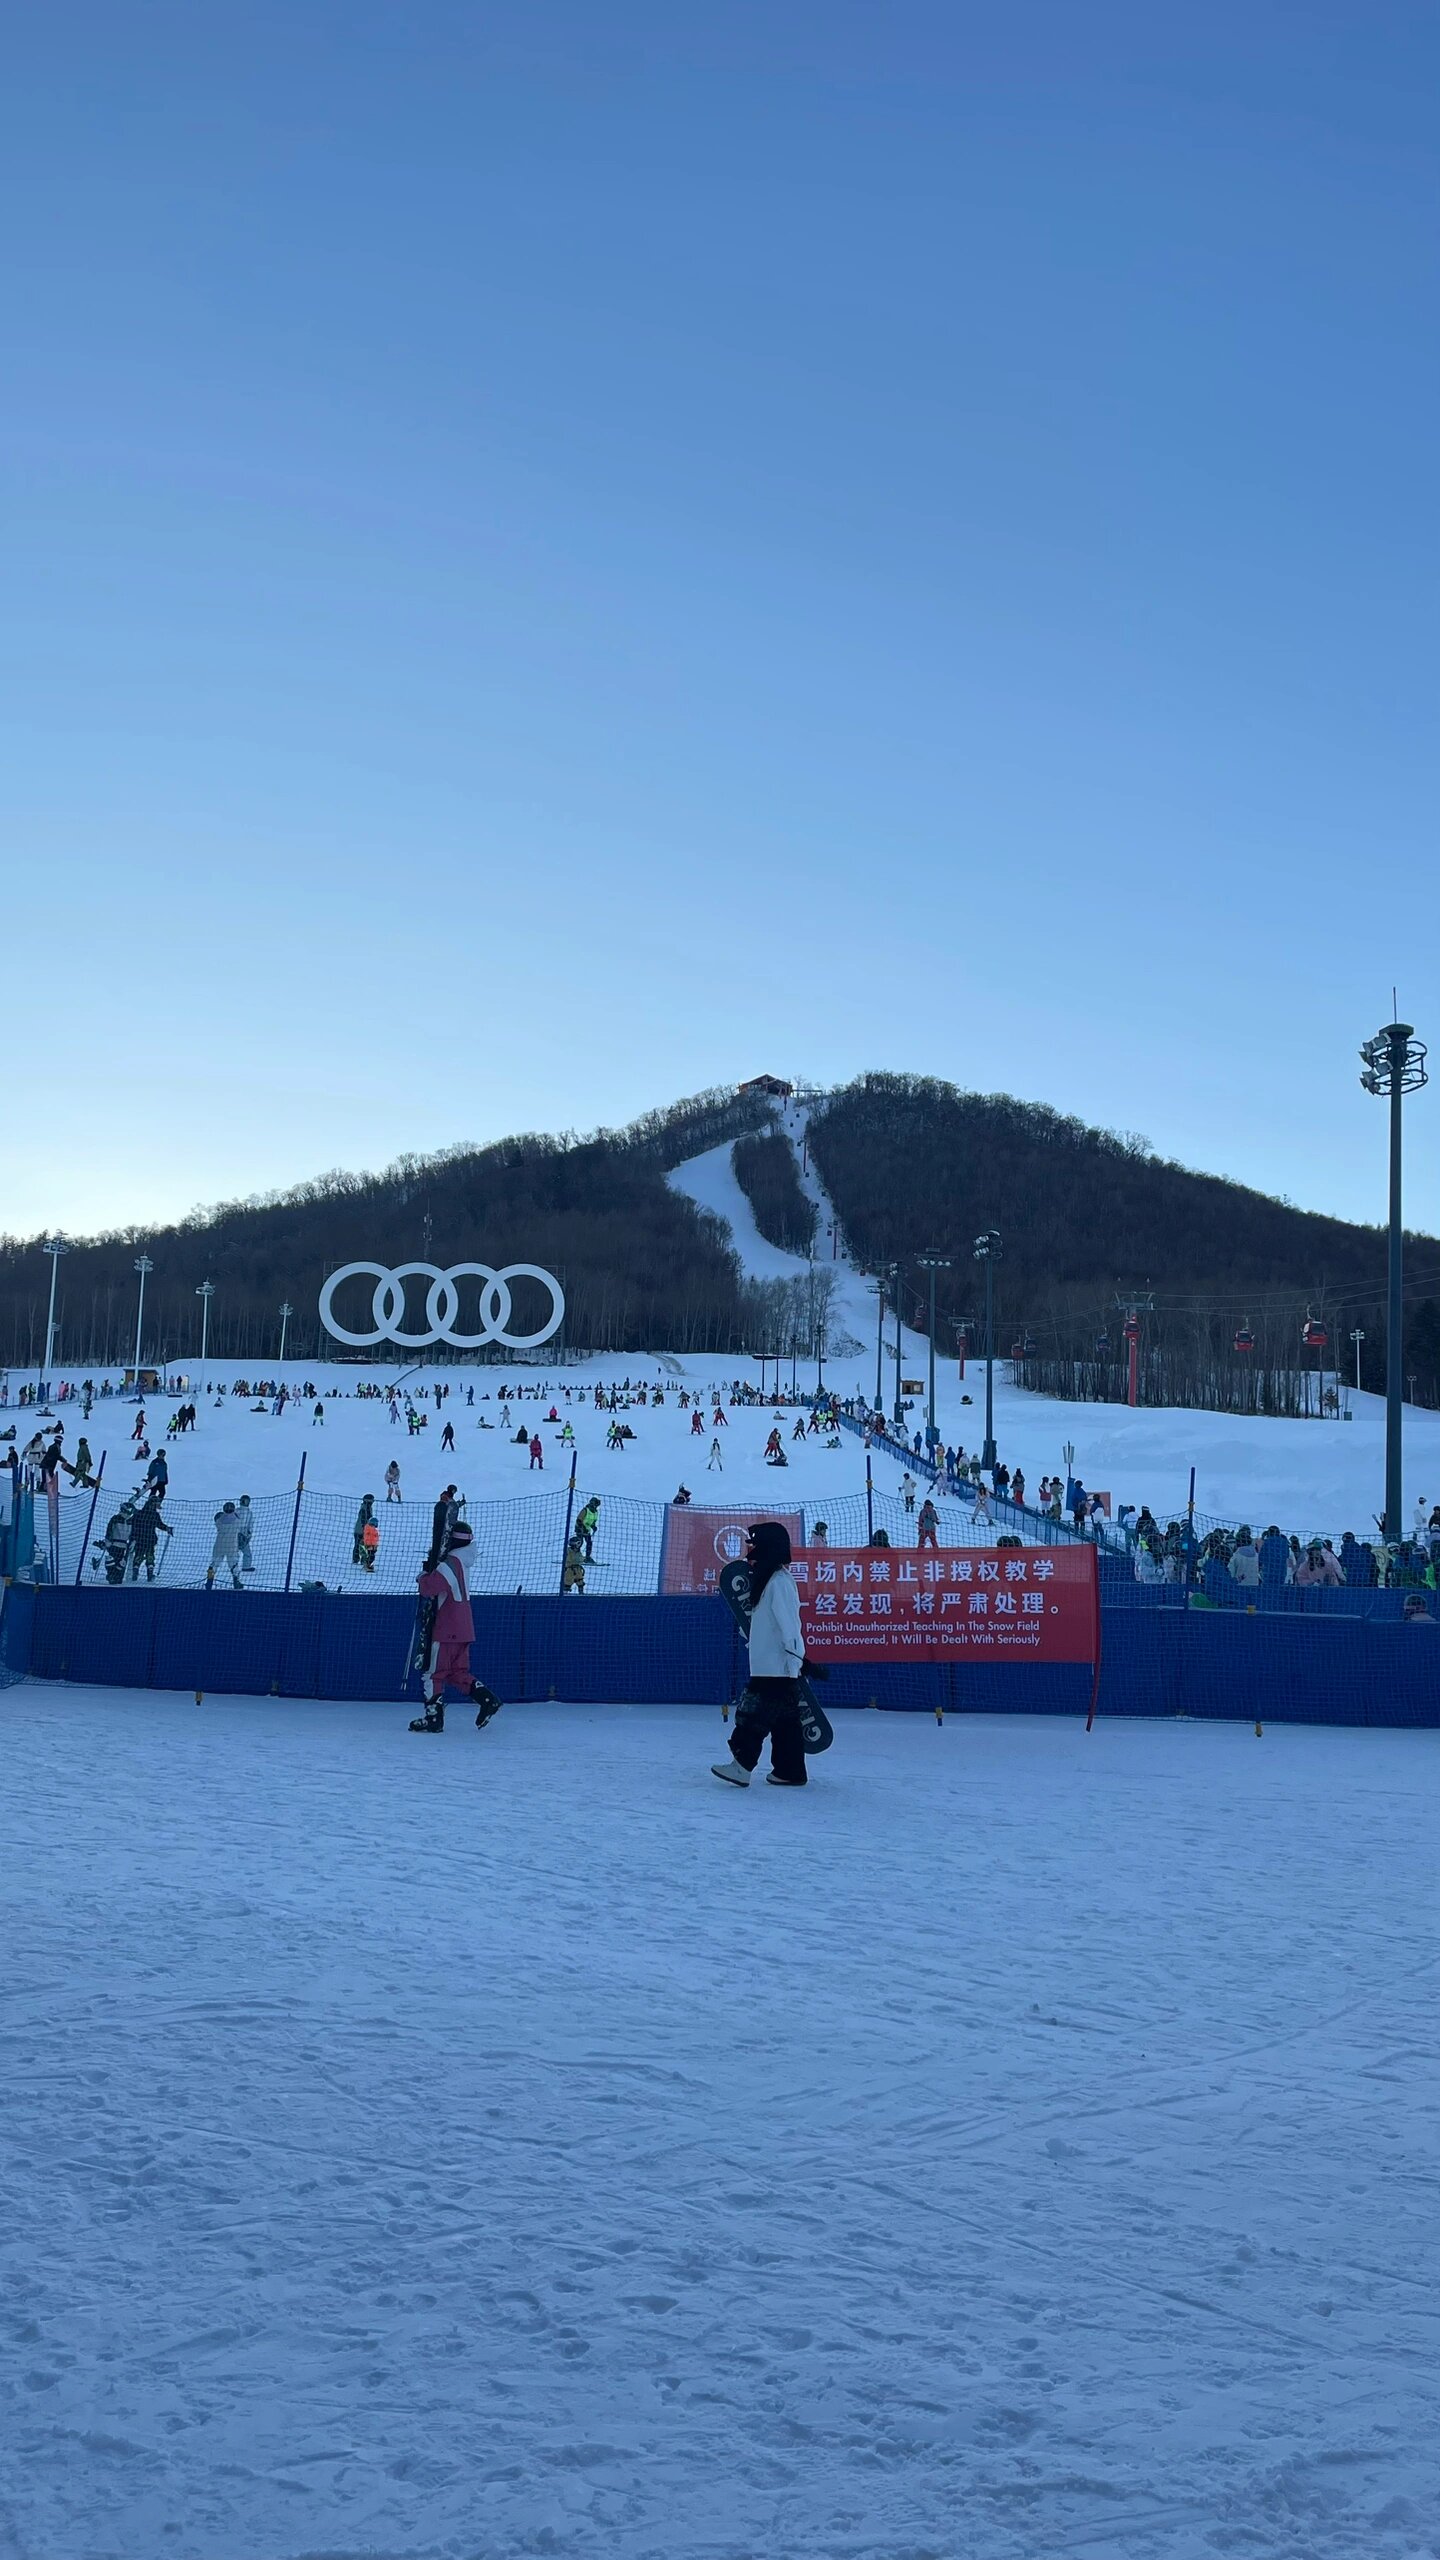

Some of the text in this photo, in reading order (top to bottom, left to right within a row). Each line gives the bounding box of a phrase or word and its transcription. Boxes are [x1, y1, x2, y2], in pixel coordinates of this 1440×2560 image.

[789, 1560, 1054, 1583] 雪场内禁止非授权教学
[806, 1620, 1040, 1633] Prohibit Unauthorized Teaching In The Snow Field
[806, 1633, 1041, 1647] Once Discovered, It Will Be Dealt With Seriously
